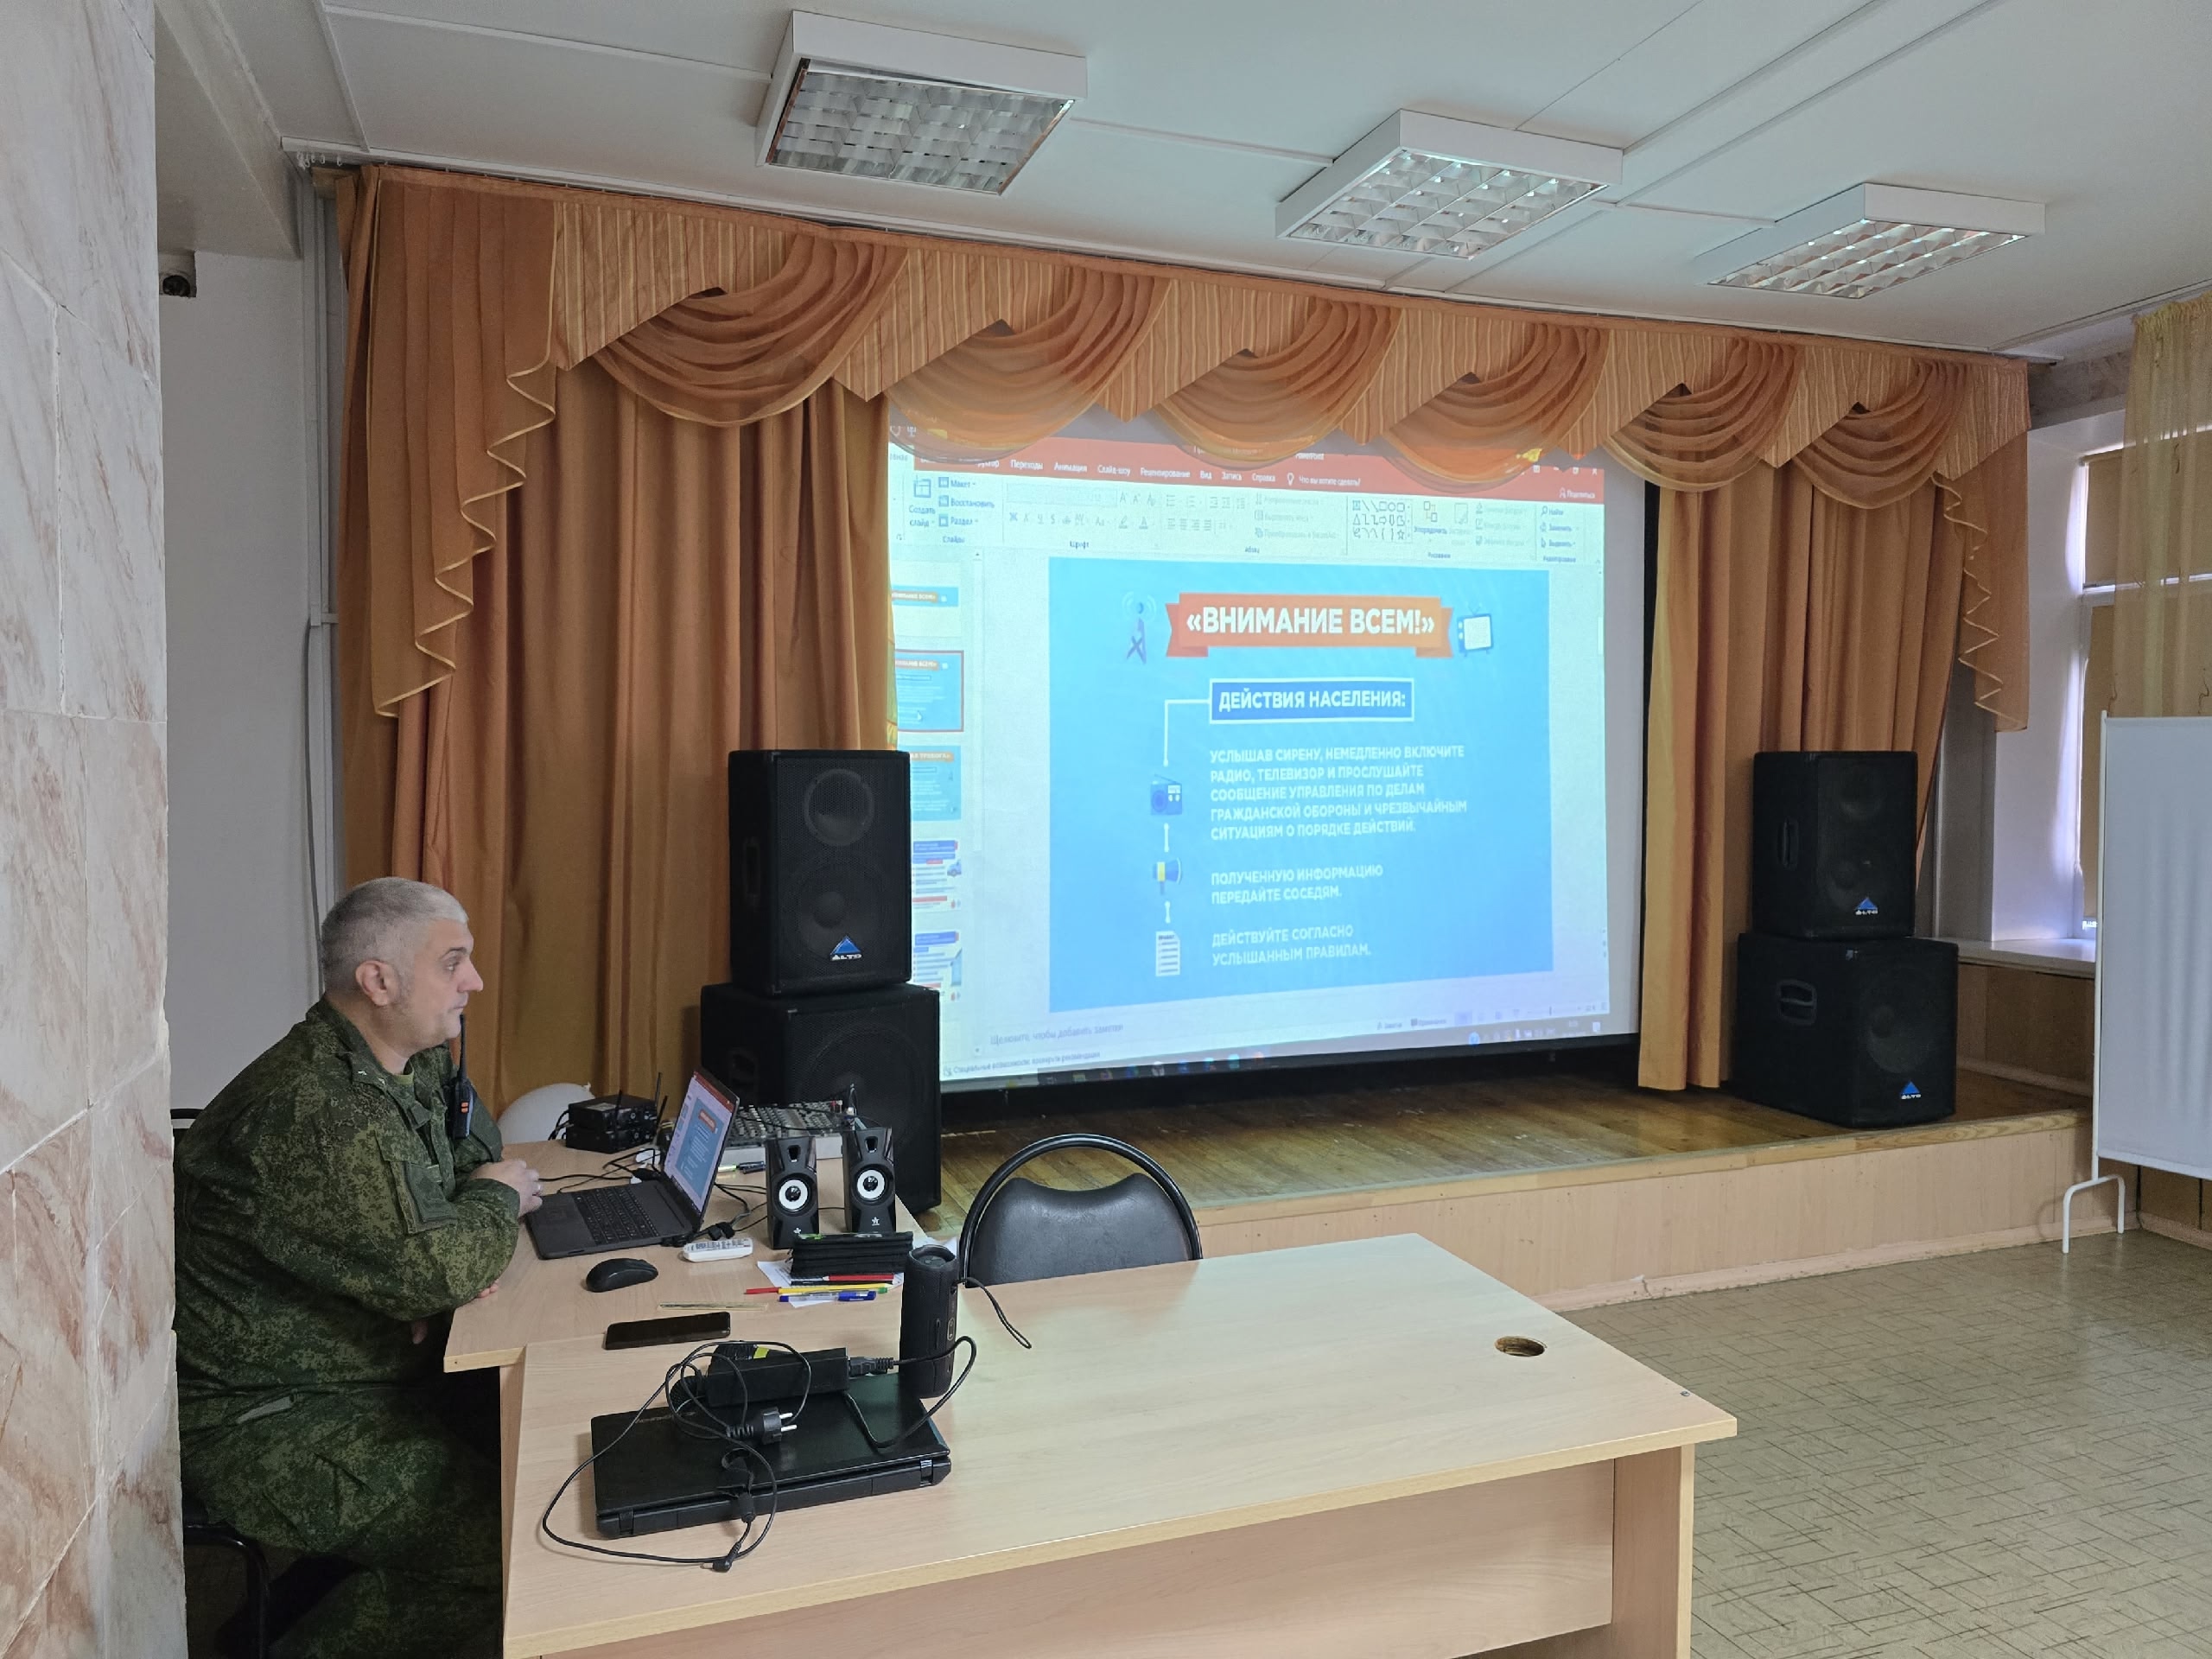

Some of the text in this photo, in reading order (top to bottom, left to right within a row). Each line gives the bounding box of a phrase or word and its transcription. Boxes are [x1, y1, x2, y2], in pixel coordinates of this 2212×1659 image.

[1010, 459, 1044, 471] Переходы
[1054, 462, 1087, 474] Анимация
[1097, 464, 1131, 476] Слайд-шоу
[1141, 467, 1191, 479] Рецензирование
[1200, 470, 1212, 480] Вид
[1222, 471, 1243, 481] Запись
[1252, 473, 1276, 484] Справка
[950, 480, 971, 488] Макет
[950, 498, 995, 509] Восстановить
[908, 505, 936, 515] Создать
[909, 518, 930, 528] слайд
[950, 517, 973, 526] Раздел
[942, 536, 965, 544] Слайды
[1186, 607, 1435, 635] «ВНИМАНИЕ ВСЕМ!»
[1218, 688, 1407, 713] ДЕЙСТВИЯ НАСЕЛЕНИЯ:
[1211, 745, 1465, 764] УСЛЫШАВ СИРЕНУ, НЕМЕДЛЕННО ВКЛЮЧИТЕ
[1211, 764, 1424, 784] РАДИО, ТЕЛЕВИЗОР И ПРОСЛУШАЙТЕ
[1211, 782, 1425, 803] СООБЩЕНИЕ УПРАВЛЕНИЯ ПО ДЕЛАМ
[1211, 800, 1467, 823] ГРАЖДАНСКОЙ ОБОРОНЫ И ЧРЕЗВЫЧАЙНЫМ
[1211, 817, 1416, 841] СИТУАЦИЯМ О ПОРЯДКЕ ДЕЙСТВИЙ.
[1211, 864, 1383, 886] ПОЛУЧЕННУЮ ИНФОРМАЦИЮ
[1211, 885, 1342, 905] ПЕРЕДАЙТЕ СОСЕДЯМ.
[1211, 925, 1354, 948] ДЕЙСТВУЙТЕ СОГЛАСНО
[1212, 943, 1372, 966] УСЛЫШАННЫМ ПРАВИЛАМ.
